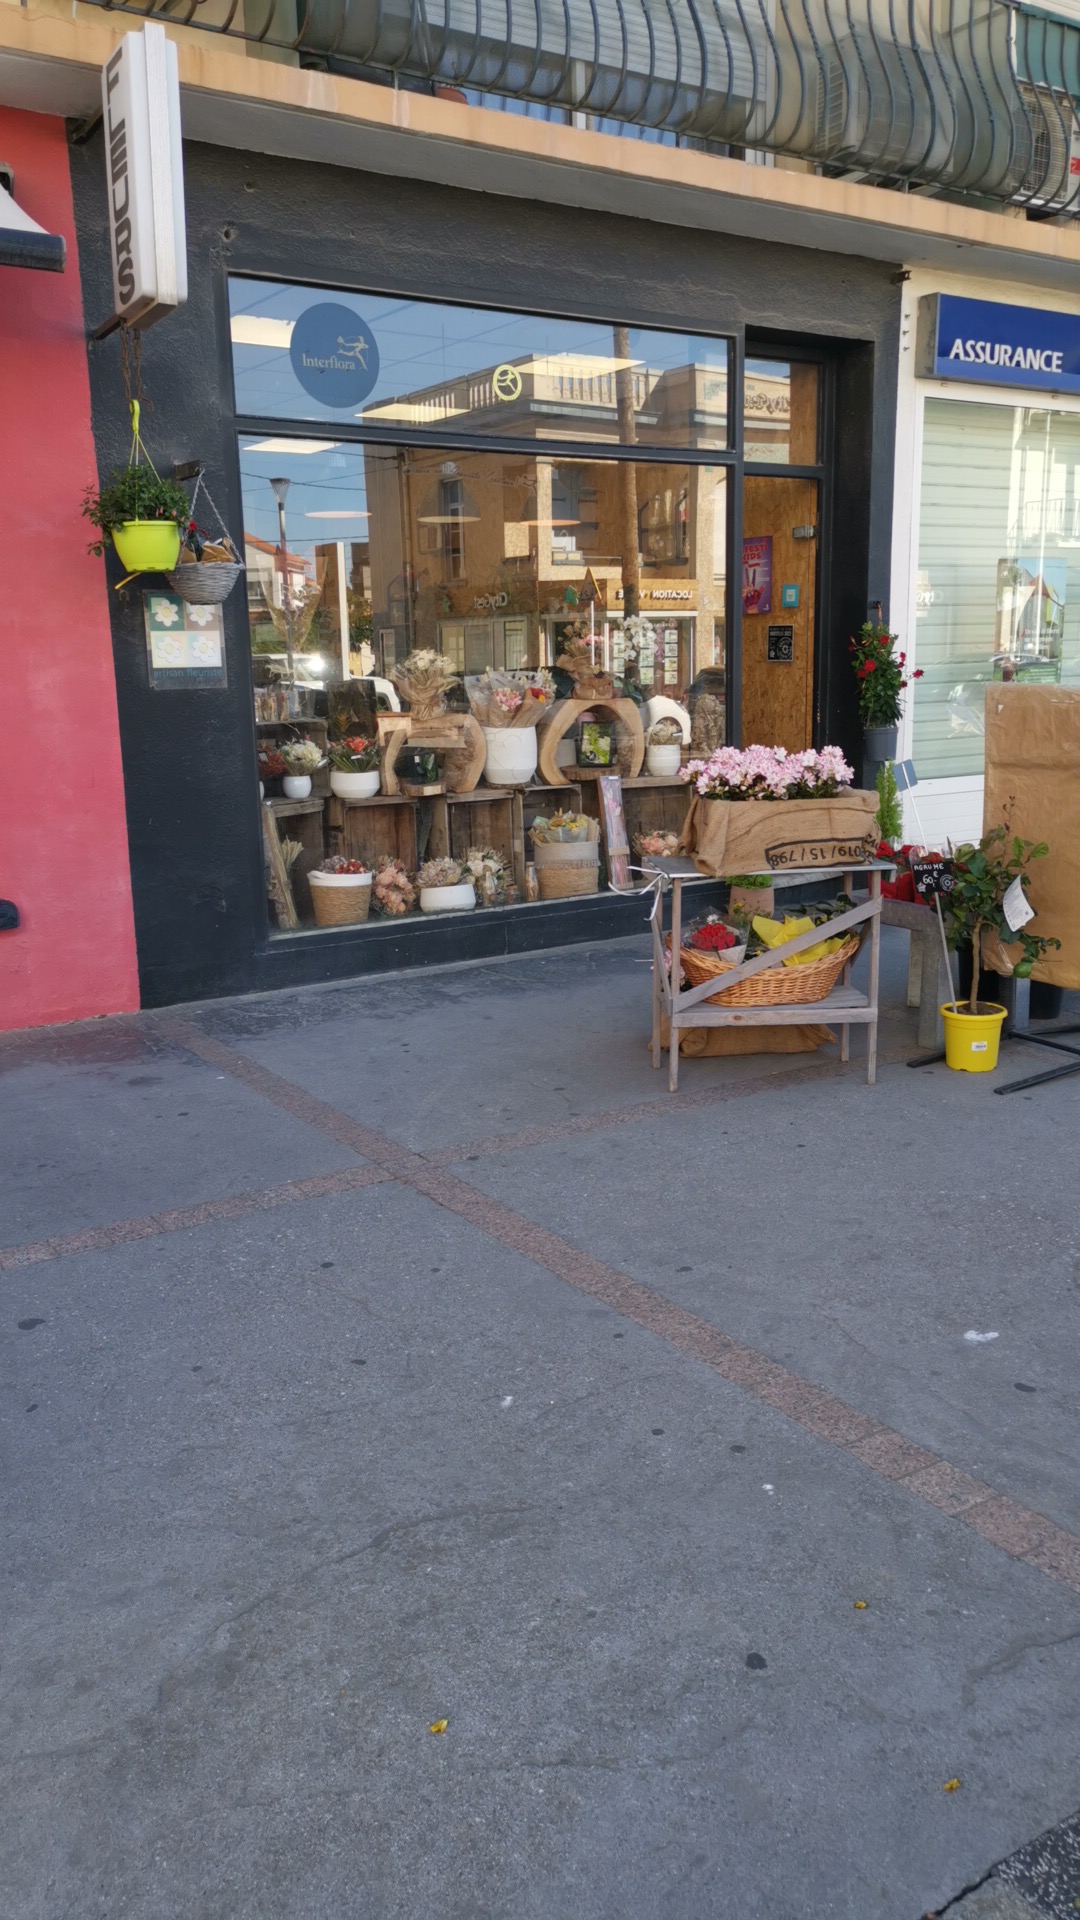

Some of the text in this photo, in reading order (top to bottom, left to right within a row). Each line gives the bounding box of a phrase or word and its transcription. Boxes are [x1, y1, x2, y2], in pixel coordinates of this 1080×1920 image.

[106, 46, 136, 306] FLEURS
[301, 352, 356, 371] Interflora
[949, 338, 1063, 373] ASSURANCE
[186, 667, 224, 678] fleuriste
